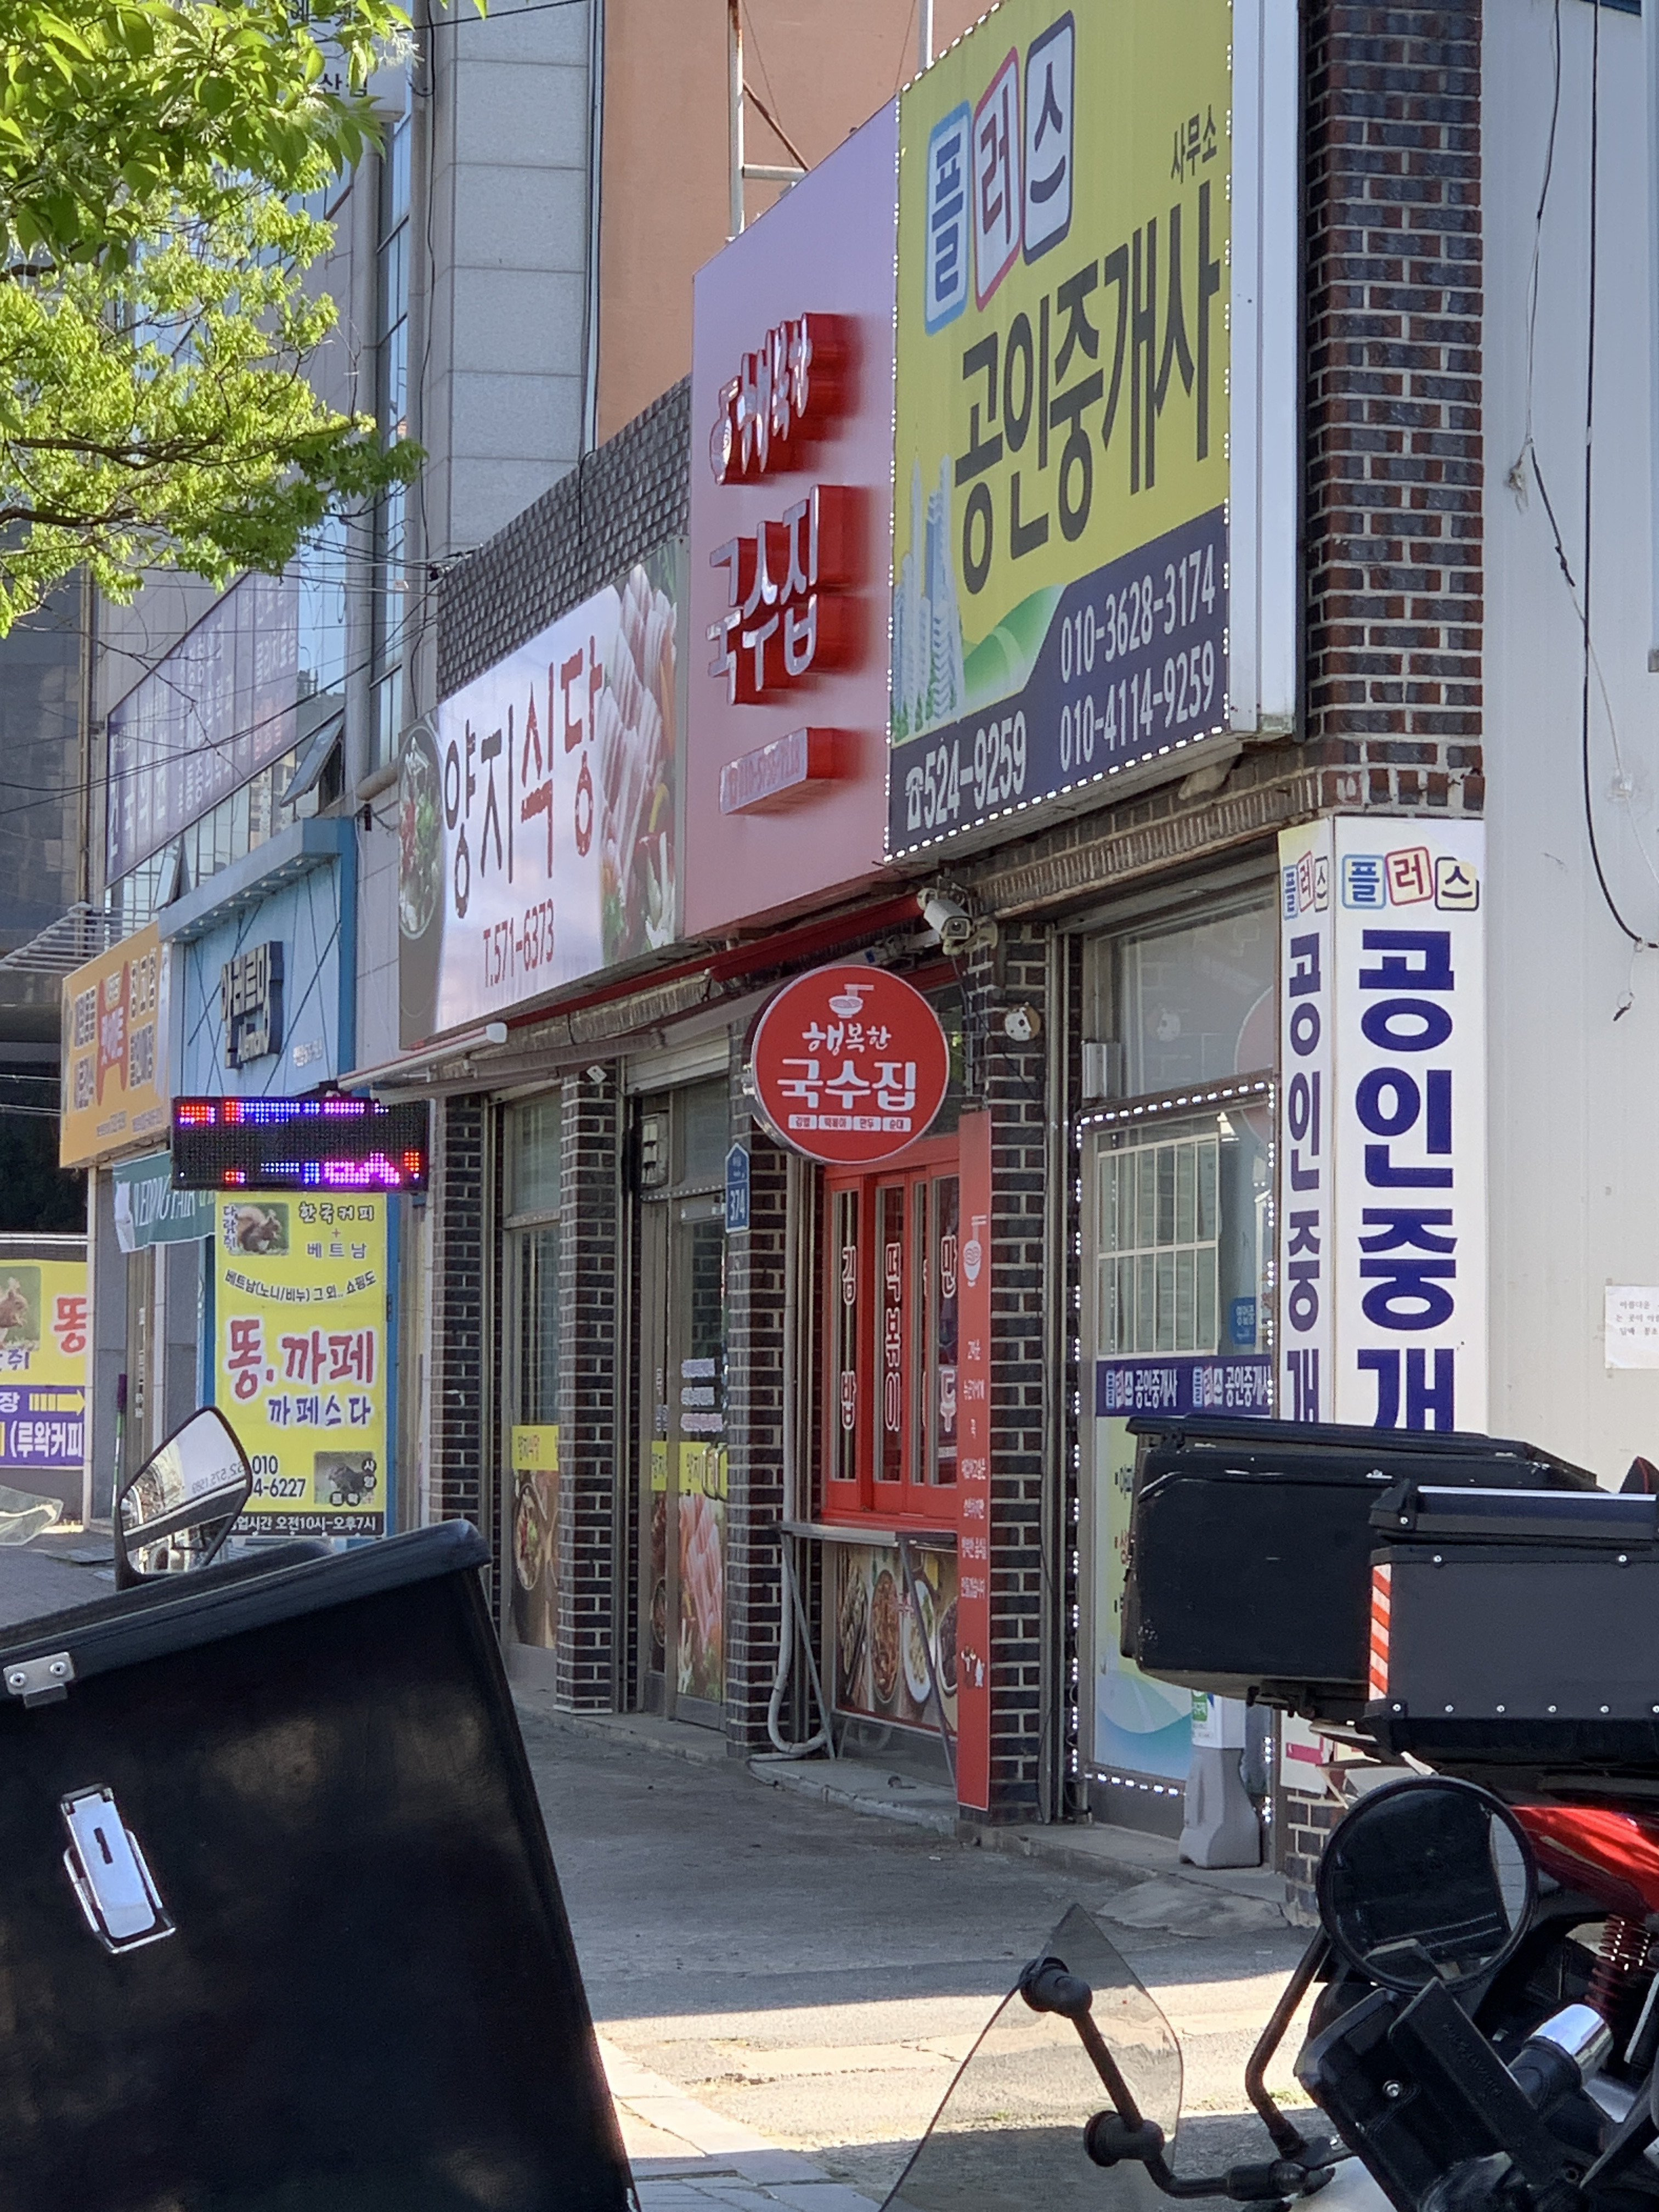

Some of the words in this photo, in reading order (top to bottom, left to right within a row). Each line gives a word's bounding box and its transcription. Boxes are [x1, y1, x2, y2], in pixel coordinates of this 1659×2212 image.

[1170, 104, 1217, 184] 사무소
[933, 61, 1067, 303] 플러스
[955, 179, 1221, 595] 공인중개사
[706, 485, 820, 704] 국수집
[1060, 544, 1215, 683] 010-3628-3174
[1059, 641, 1215, 772] 010-4114-9259
[444, 635, 603, 919] 양지식당
[1348, 854, 1473, 902] 플러스
[483, 898, 555, 988] T.571-6373
[802, 1022, 892, 1056] 행복한
[777, 1058, 916, 1111] 국수집
[299, 1203, 375, 1223] 한국커피
[730, 1188, 745, 1221] 374
[307, 1243, 366, 1259] 베트남
[225, 1269, 311, 1302] 베트남(노니/비누)
[313, 1288, 324, 1300] 그
[346, 1271, 376, 1295] 쇼핑도
[268, 1395, 371, 1426] 까페스다
[252, 1455, 278, 1475] 010
[253, 1479, 306, 1497] 4-6227
